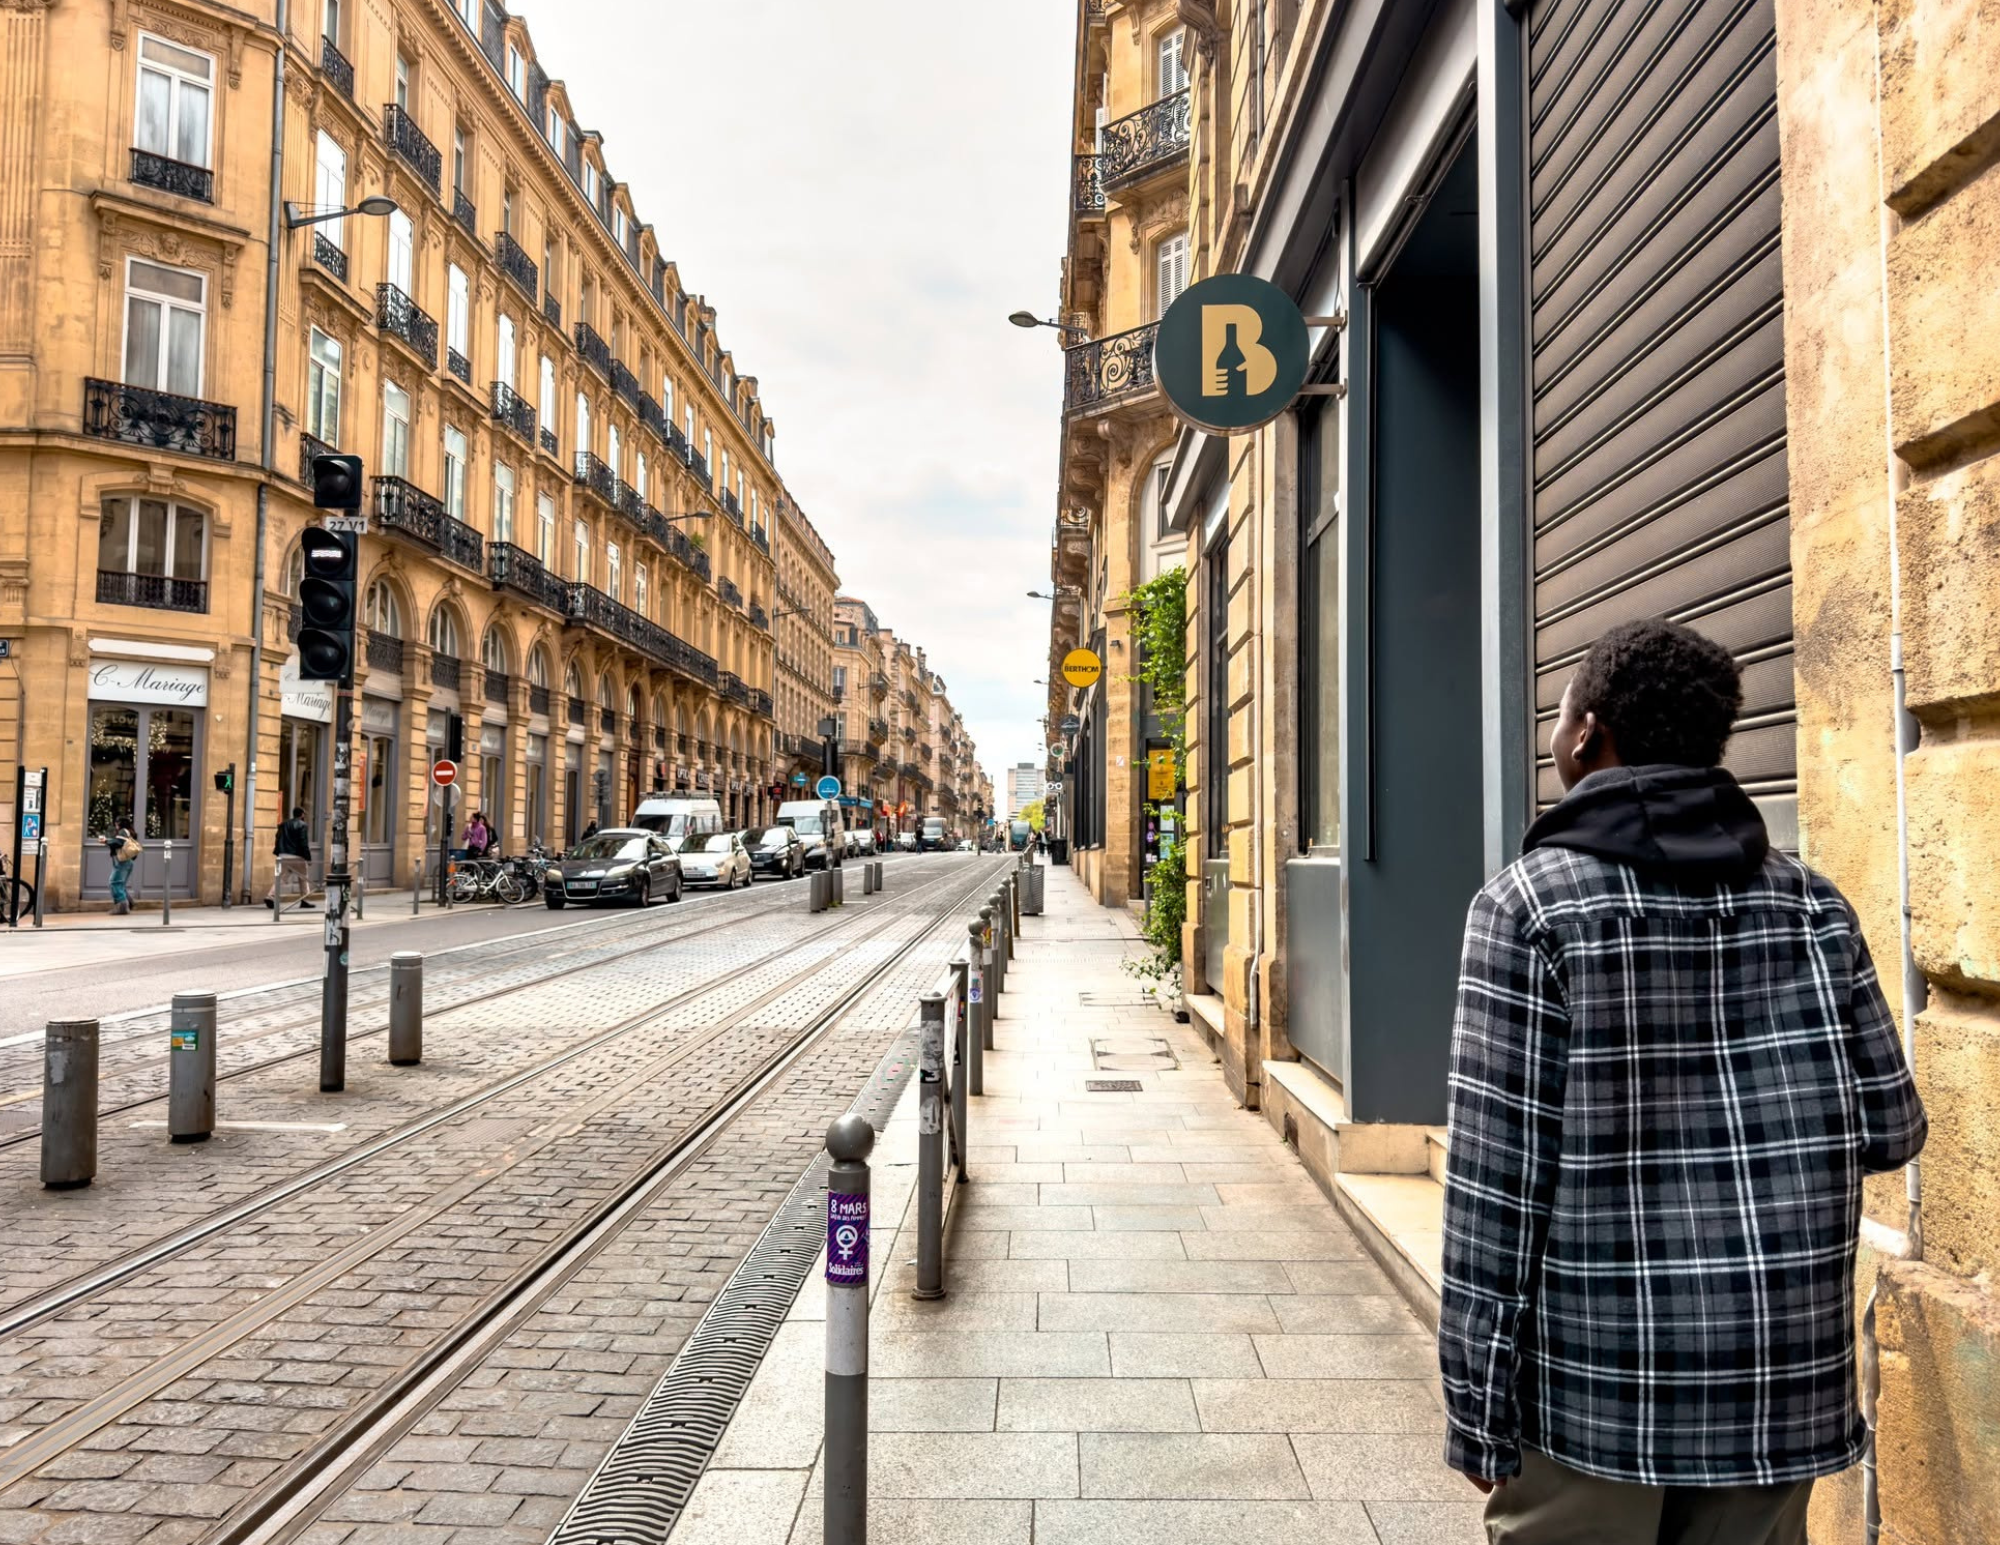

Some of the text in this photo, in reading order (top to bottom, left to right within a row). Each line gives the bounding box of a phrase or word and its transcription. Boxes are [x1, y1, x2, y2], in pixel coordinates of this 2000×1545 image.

[1202, 304, 1277, 396] B
[330, 521, 365, 531] 27 V1
[111, 714, 138, 727] LOV
[831, 1199, 867, 1215] 8 MARS
[829, 1262, 864, 1276] Solidaires
